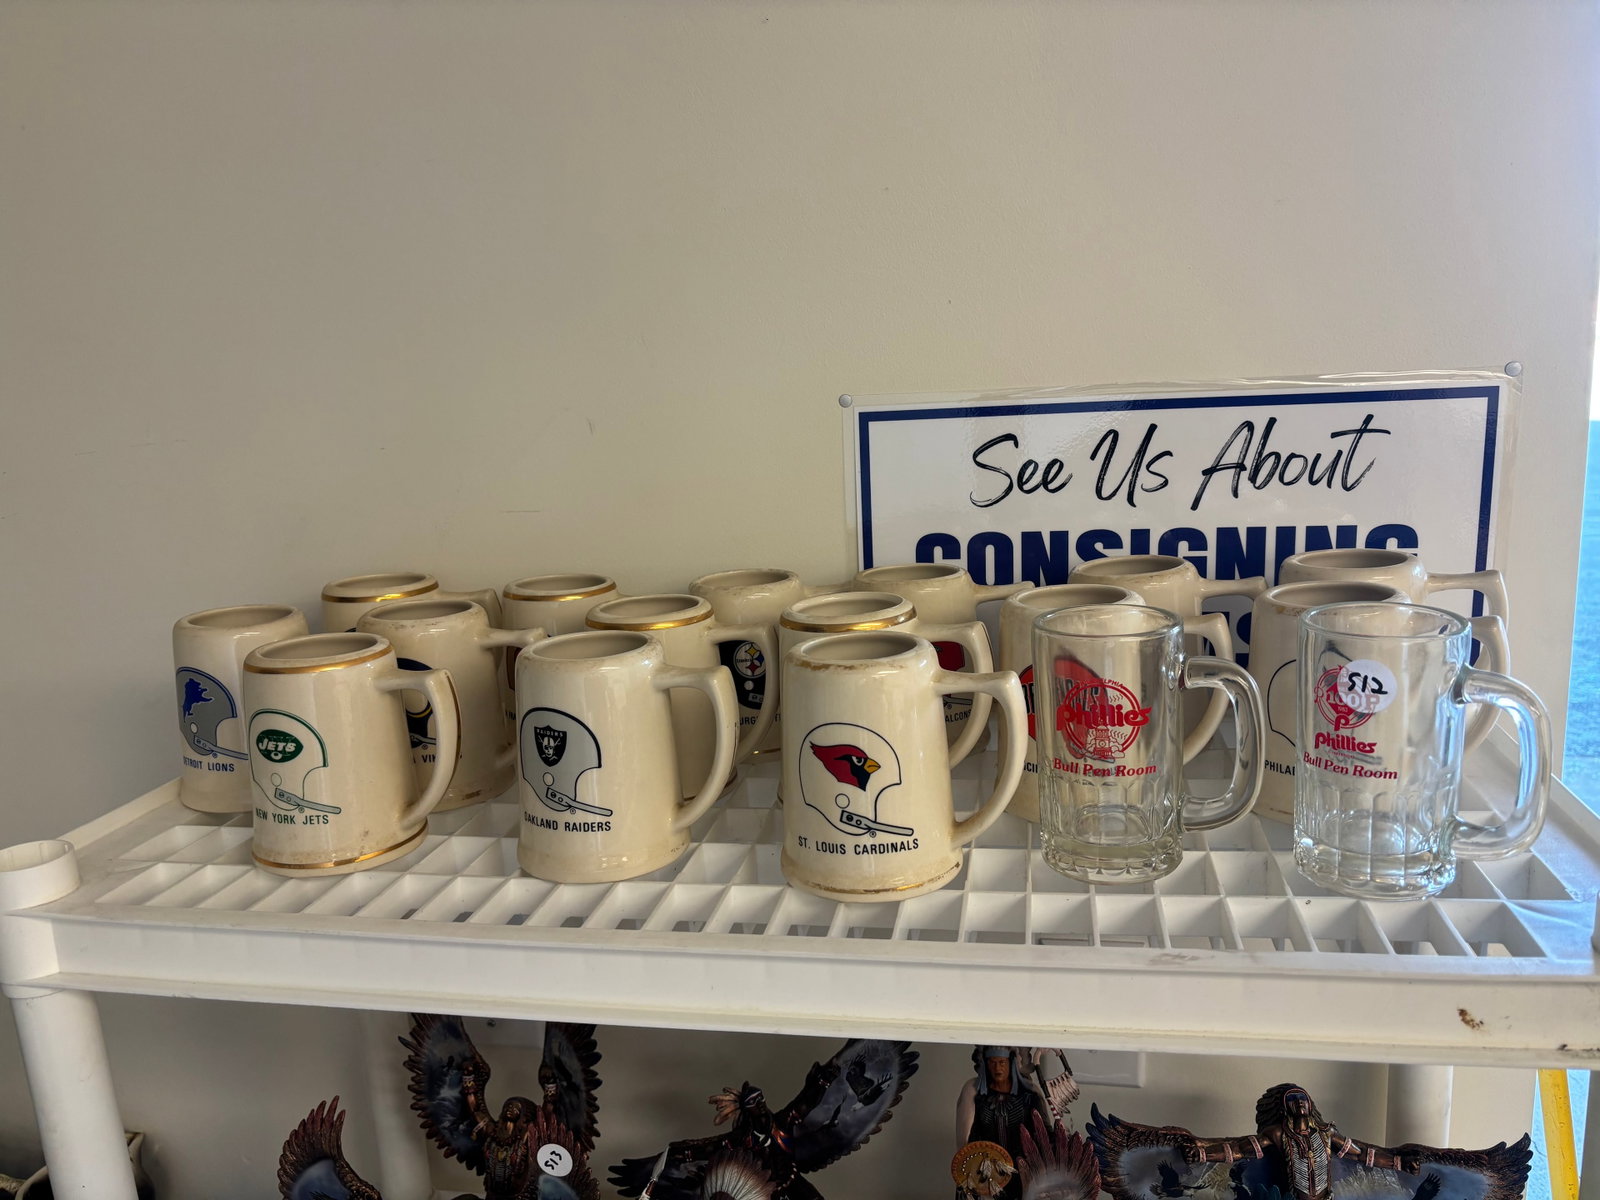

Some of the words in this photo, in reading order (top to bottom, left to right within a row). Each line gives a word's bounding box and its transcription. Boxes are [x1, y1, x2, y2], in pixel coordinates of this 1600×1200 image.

[969, 432, 1074, 508] See
[1090, 422, 1174, 508] Us
[1190, 413, 1391, 510] About
[945, 709, 972, 722] ALCON
[1056, 702, 1153, 732] Phillies
[536, 728, 563, 738] RAIDERS
[1314, 731, 1378, 754] Phillies
[258, 738, 297, 752] JETS
[183, 756, 203, 770] DETROIT
[207, 762, 235, 772] LIONS
[1053, 758, 1079, 774] Bull
[1082, 763, 1112, 777] Pen
[1115, 764, 1157, 777] Room
[1303, 751, 1321, 768] Bull
[1324, 760, 1349, 775] Pen
[1352, 765, 1398, 779] Room
[256, 808, 268, 820] NEW
[272, 813, 296, 825] YORK
[302, 814, 329, 825] JETS
[524, 811, 559, 831] OAKLAND
[564, 821, 611, 833] RAIDERS
[798, 835, 811, 849] ST.
[816, 840, 847, 855] LOUIS
[854, 838, 919, 855] CARDINALS
